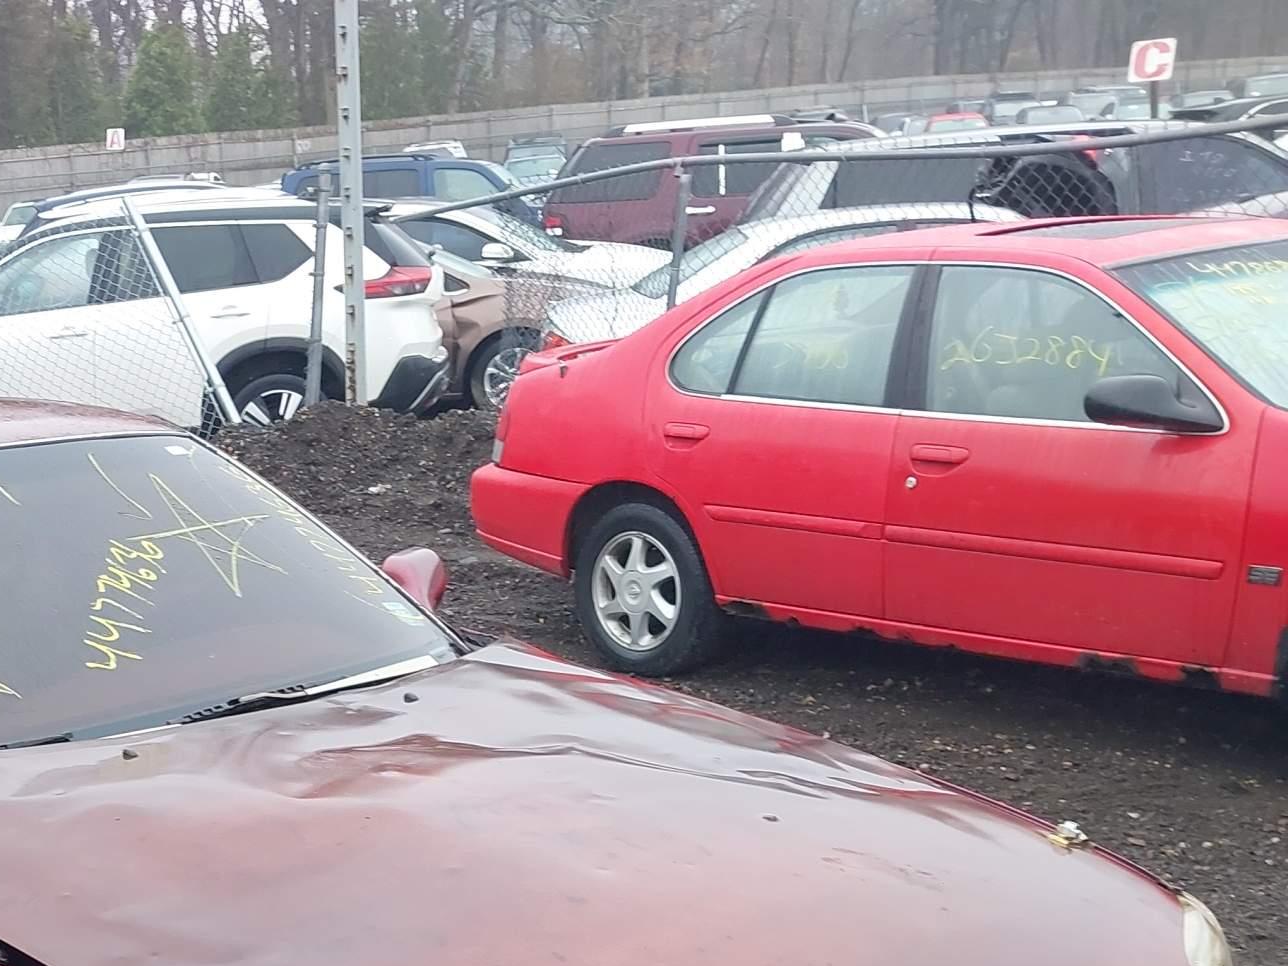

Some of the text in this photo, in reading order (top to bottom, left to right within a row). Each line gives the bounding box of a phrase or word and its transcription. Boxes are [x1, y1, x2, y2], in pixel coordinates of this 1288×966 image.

[1134, 42, 1169, 79] C
[110, 130, 121, 148] A
[83, 538, 167, 671] 44774636
